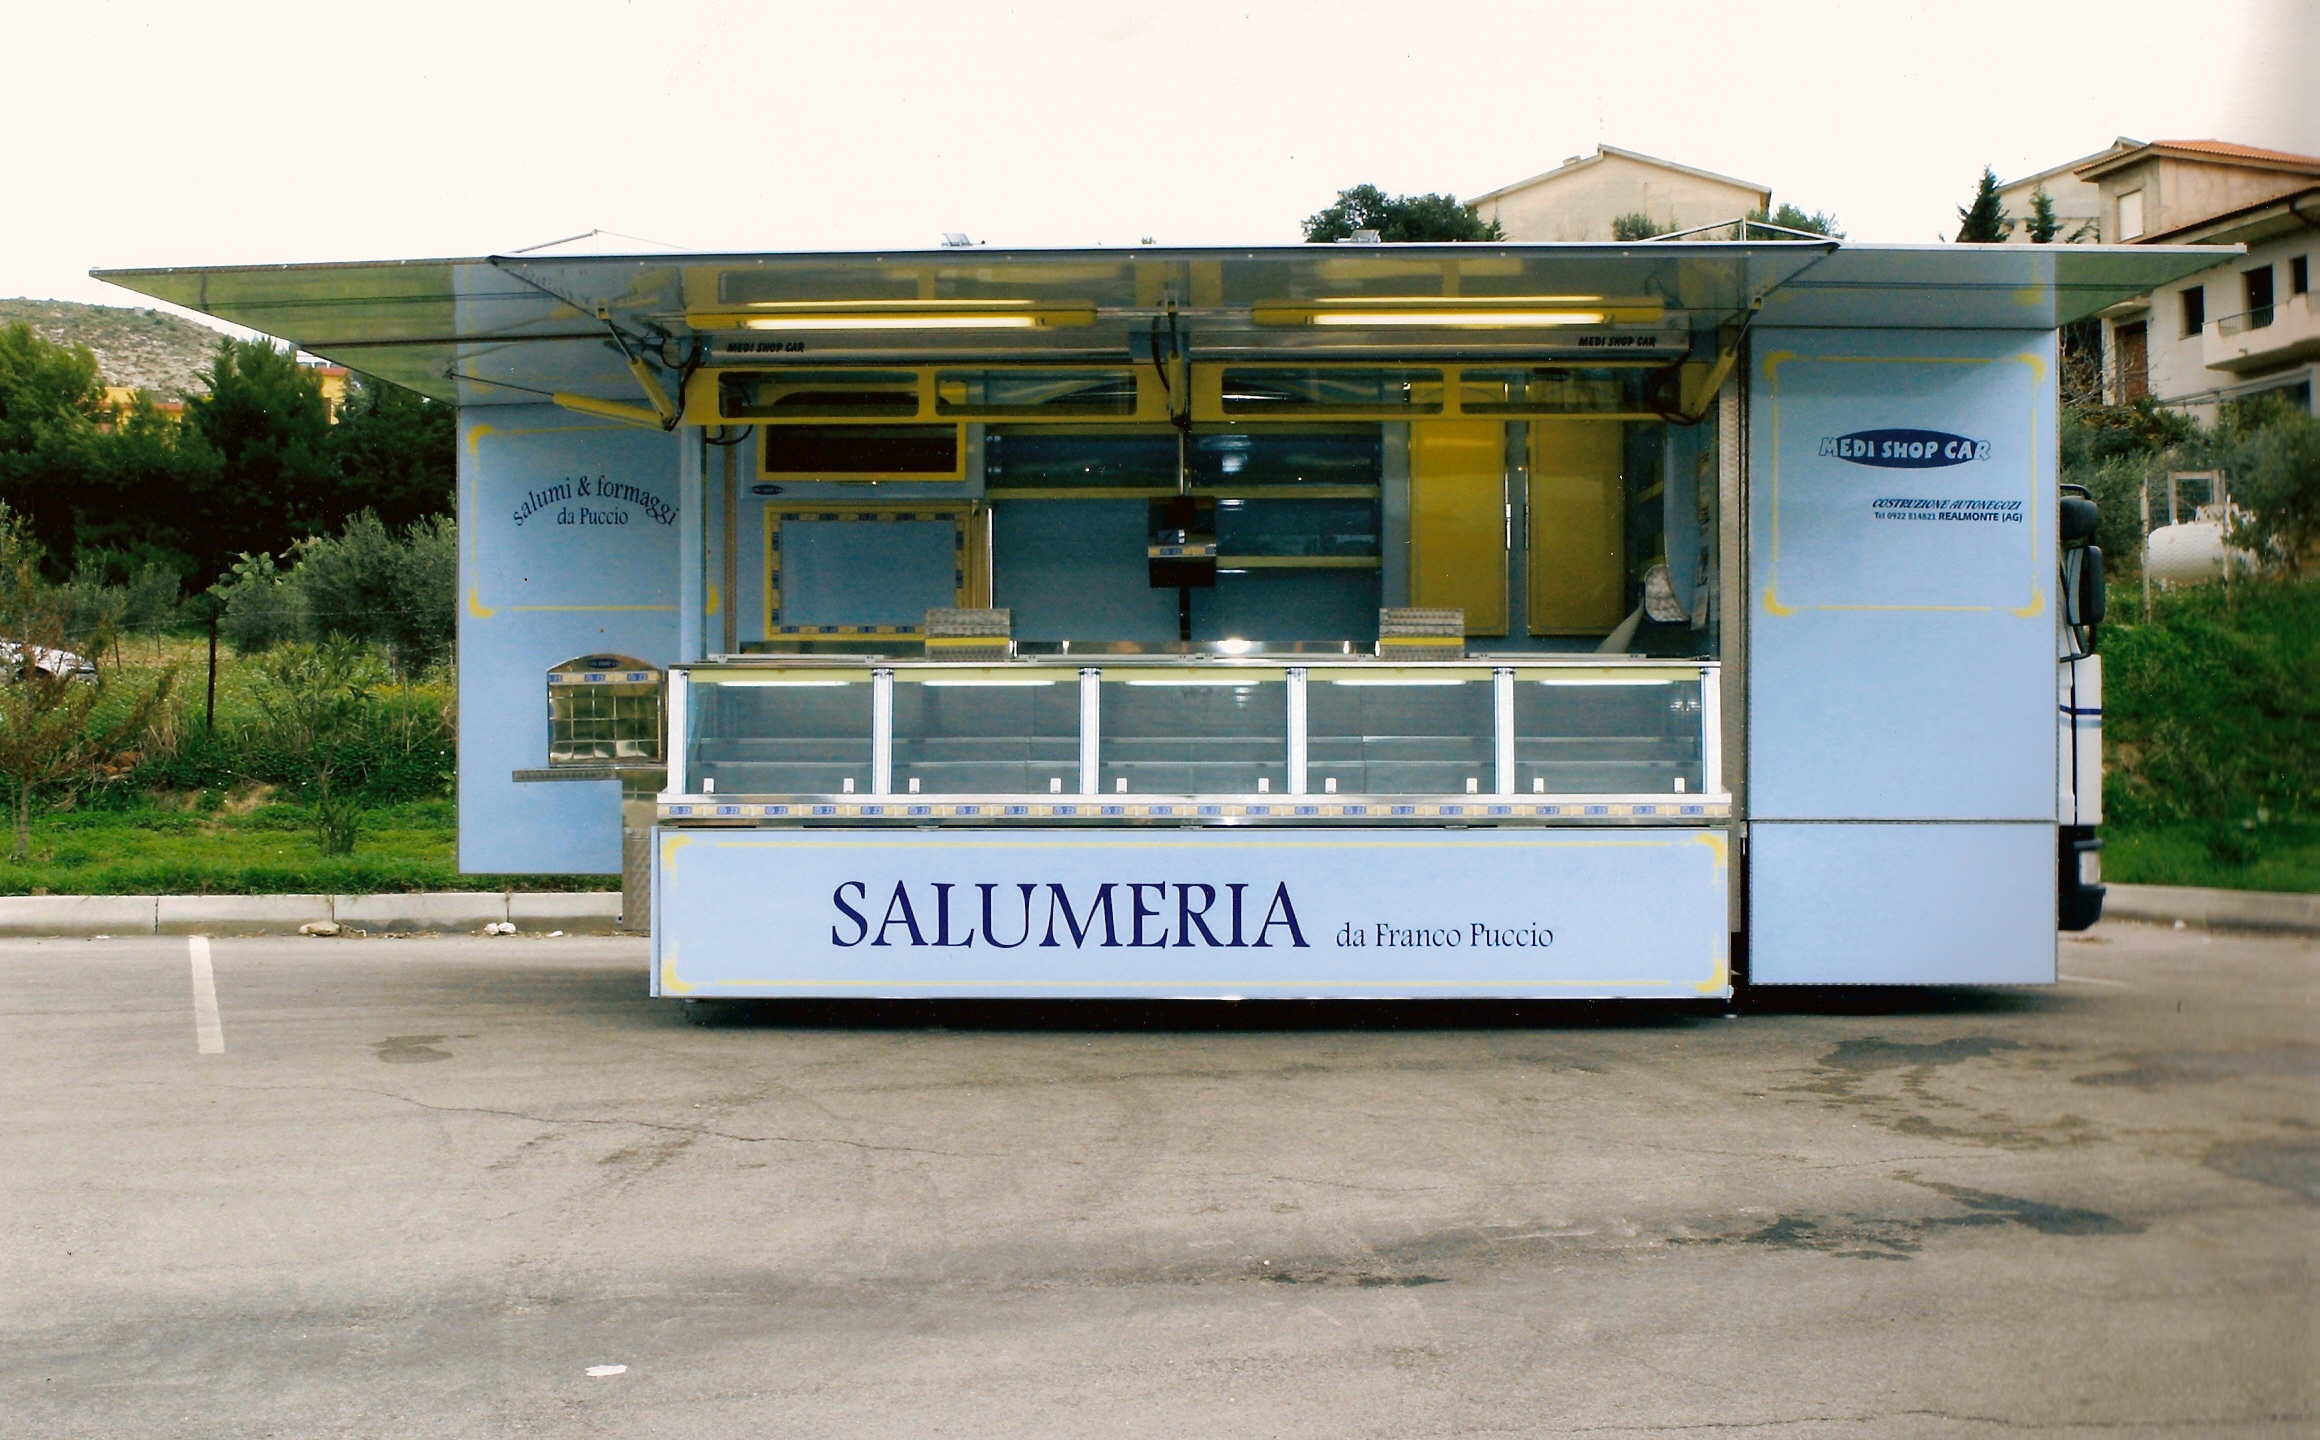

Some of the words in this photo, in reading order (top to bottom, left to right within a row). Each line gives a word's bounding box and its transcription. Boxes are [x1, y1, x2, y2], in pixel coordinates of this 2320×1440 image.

[726, 342, 754, 353] MEDI
[756, 342, 783, 353] SHOP
[785, 341, 805, 353] CAR
[1578, 336, 1606, 347] MEDI
[1607, 336, 1635, 347] SHOP
[1636, 336, 1657, 347] CAR
[1819, 437, 1875, 458] MEDI
[1881, 440, 1939, 460] SHOP
[1944, 439, 1992, 462] CAR
[513, 476, 572, 526] salumi
[577, 475, 592, 497] &
[597, 474, 680, 526] formaggi
[1872, 499, 1949, 510] COSTRUZIONE
[1949, 500, 2022, 511] AUTONEGOZI
[557, 507, 575, 525] da
[580, 507, 629, 525] Puccio
[1875, 512, 1886, 520] Tel
[1887, 512, 1907, 520] 0922
[1938, 511, 1999, 522] REALMONTE
[2001, 512, 2023, 523] (AG)
[831, 880, 1311, 950] SALUMERIA
[1336, 921, 1367, 948] da
[1375, 923, 1462, 948] Franco
[1470, 922, 1555, 948] Puccio
